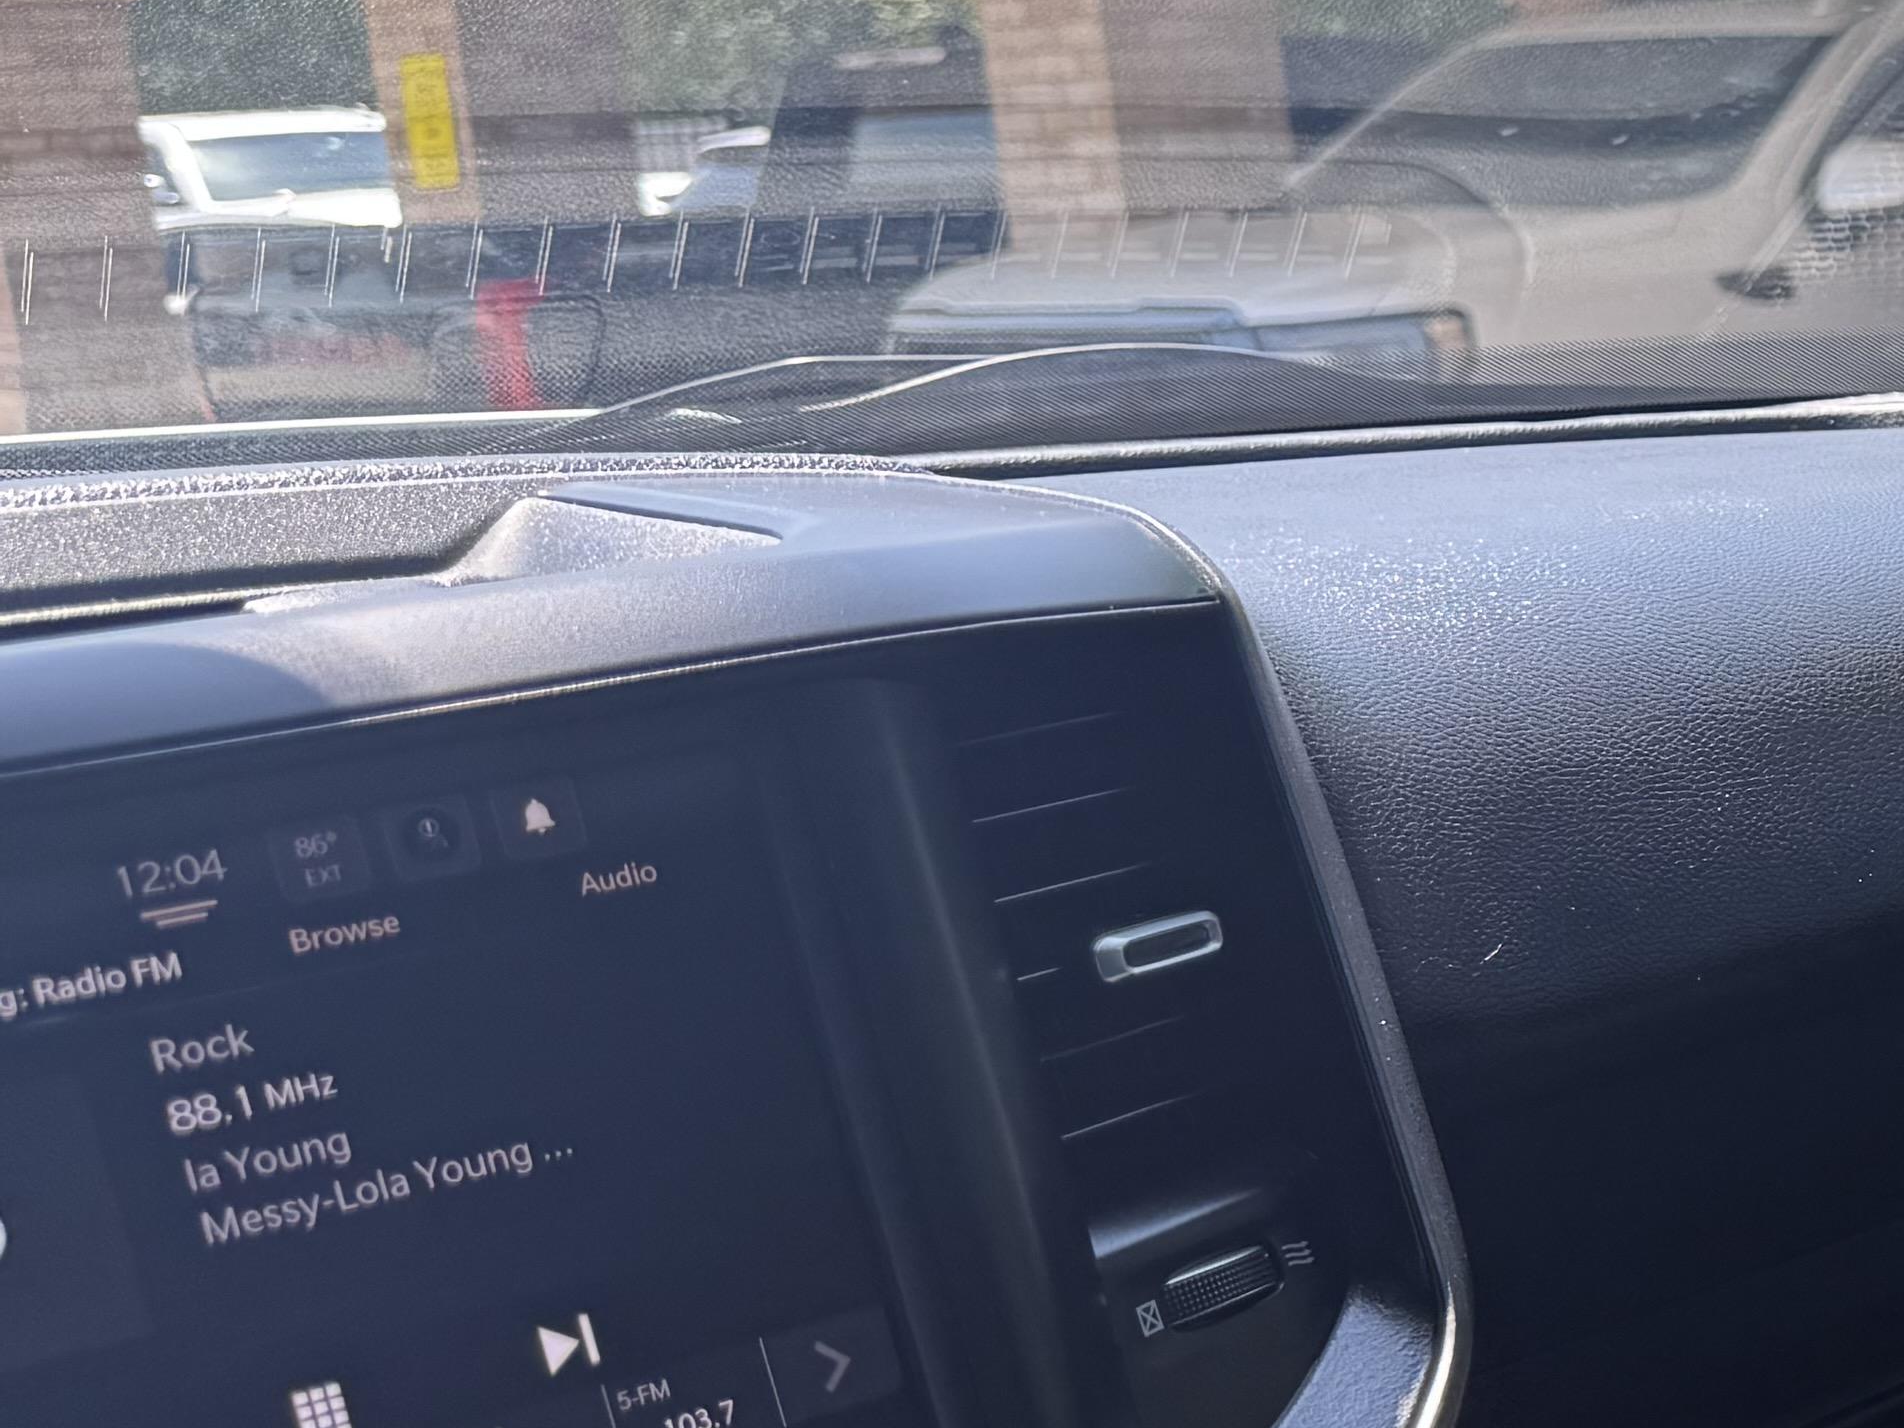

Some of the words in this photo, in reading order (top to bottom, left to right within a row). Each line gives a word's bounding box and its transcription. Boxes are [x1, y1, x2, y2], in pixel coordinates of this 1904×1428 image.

[116, 849, 227, 898] 12:04
[304, 864, 343, 889] EXT
[581, 861, 657, 896] Audio
[287, 915, 401, 955] Browse
[32, 965, 127, 1007] Radio
[130, 951, 183, 988] FM
[149, 1023, 255, 1073] Rock
[166, 1084, 253, 1134] 88.1
[262, 1072, 339, 1110] MHz
[224, 1131, 352, 1181] Young
[200, 1168, 411, 1246] Messy-Lola
[412, 1140, 534, 1189] Young
[616, 1378, 672, 1413] 5-FM
